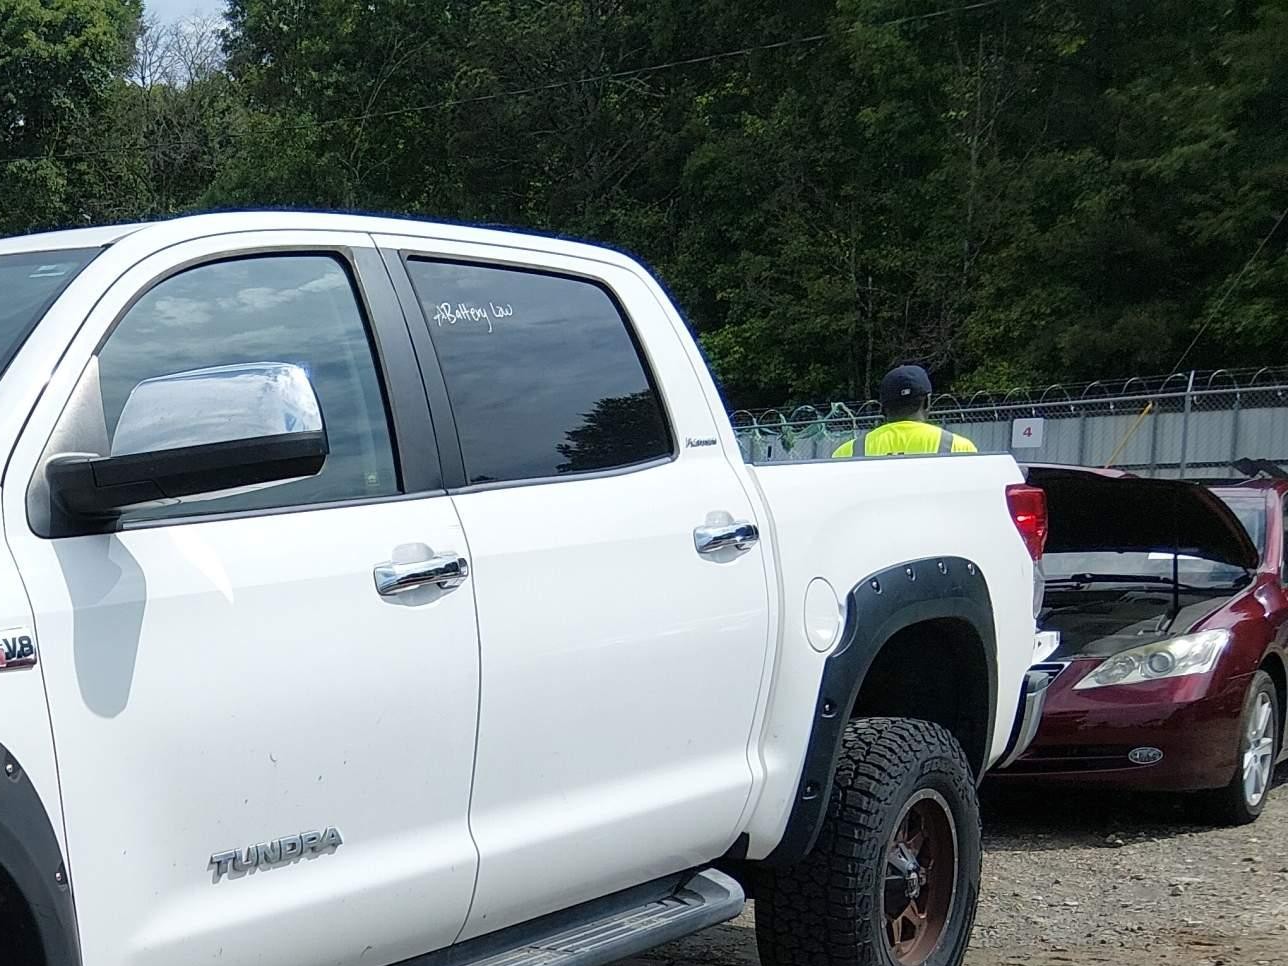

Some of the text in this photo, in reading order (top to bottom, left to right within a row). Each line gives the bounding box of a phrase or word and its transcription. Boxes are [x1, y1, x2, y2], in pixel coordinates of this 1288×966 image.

[1022, 426, 1033, 438] 4
[2, 635, 34, 660] V8
[207, 826, 344, 881] TUNDRA
